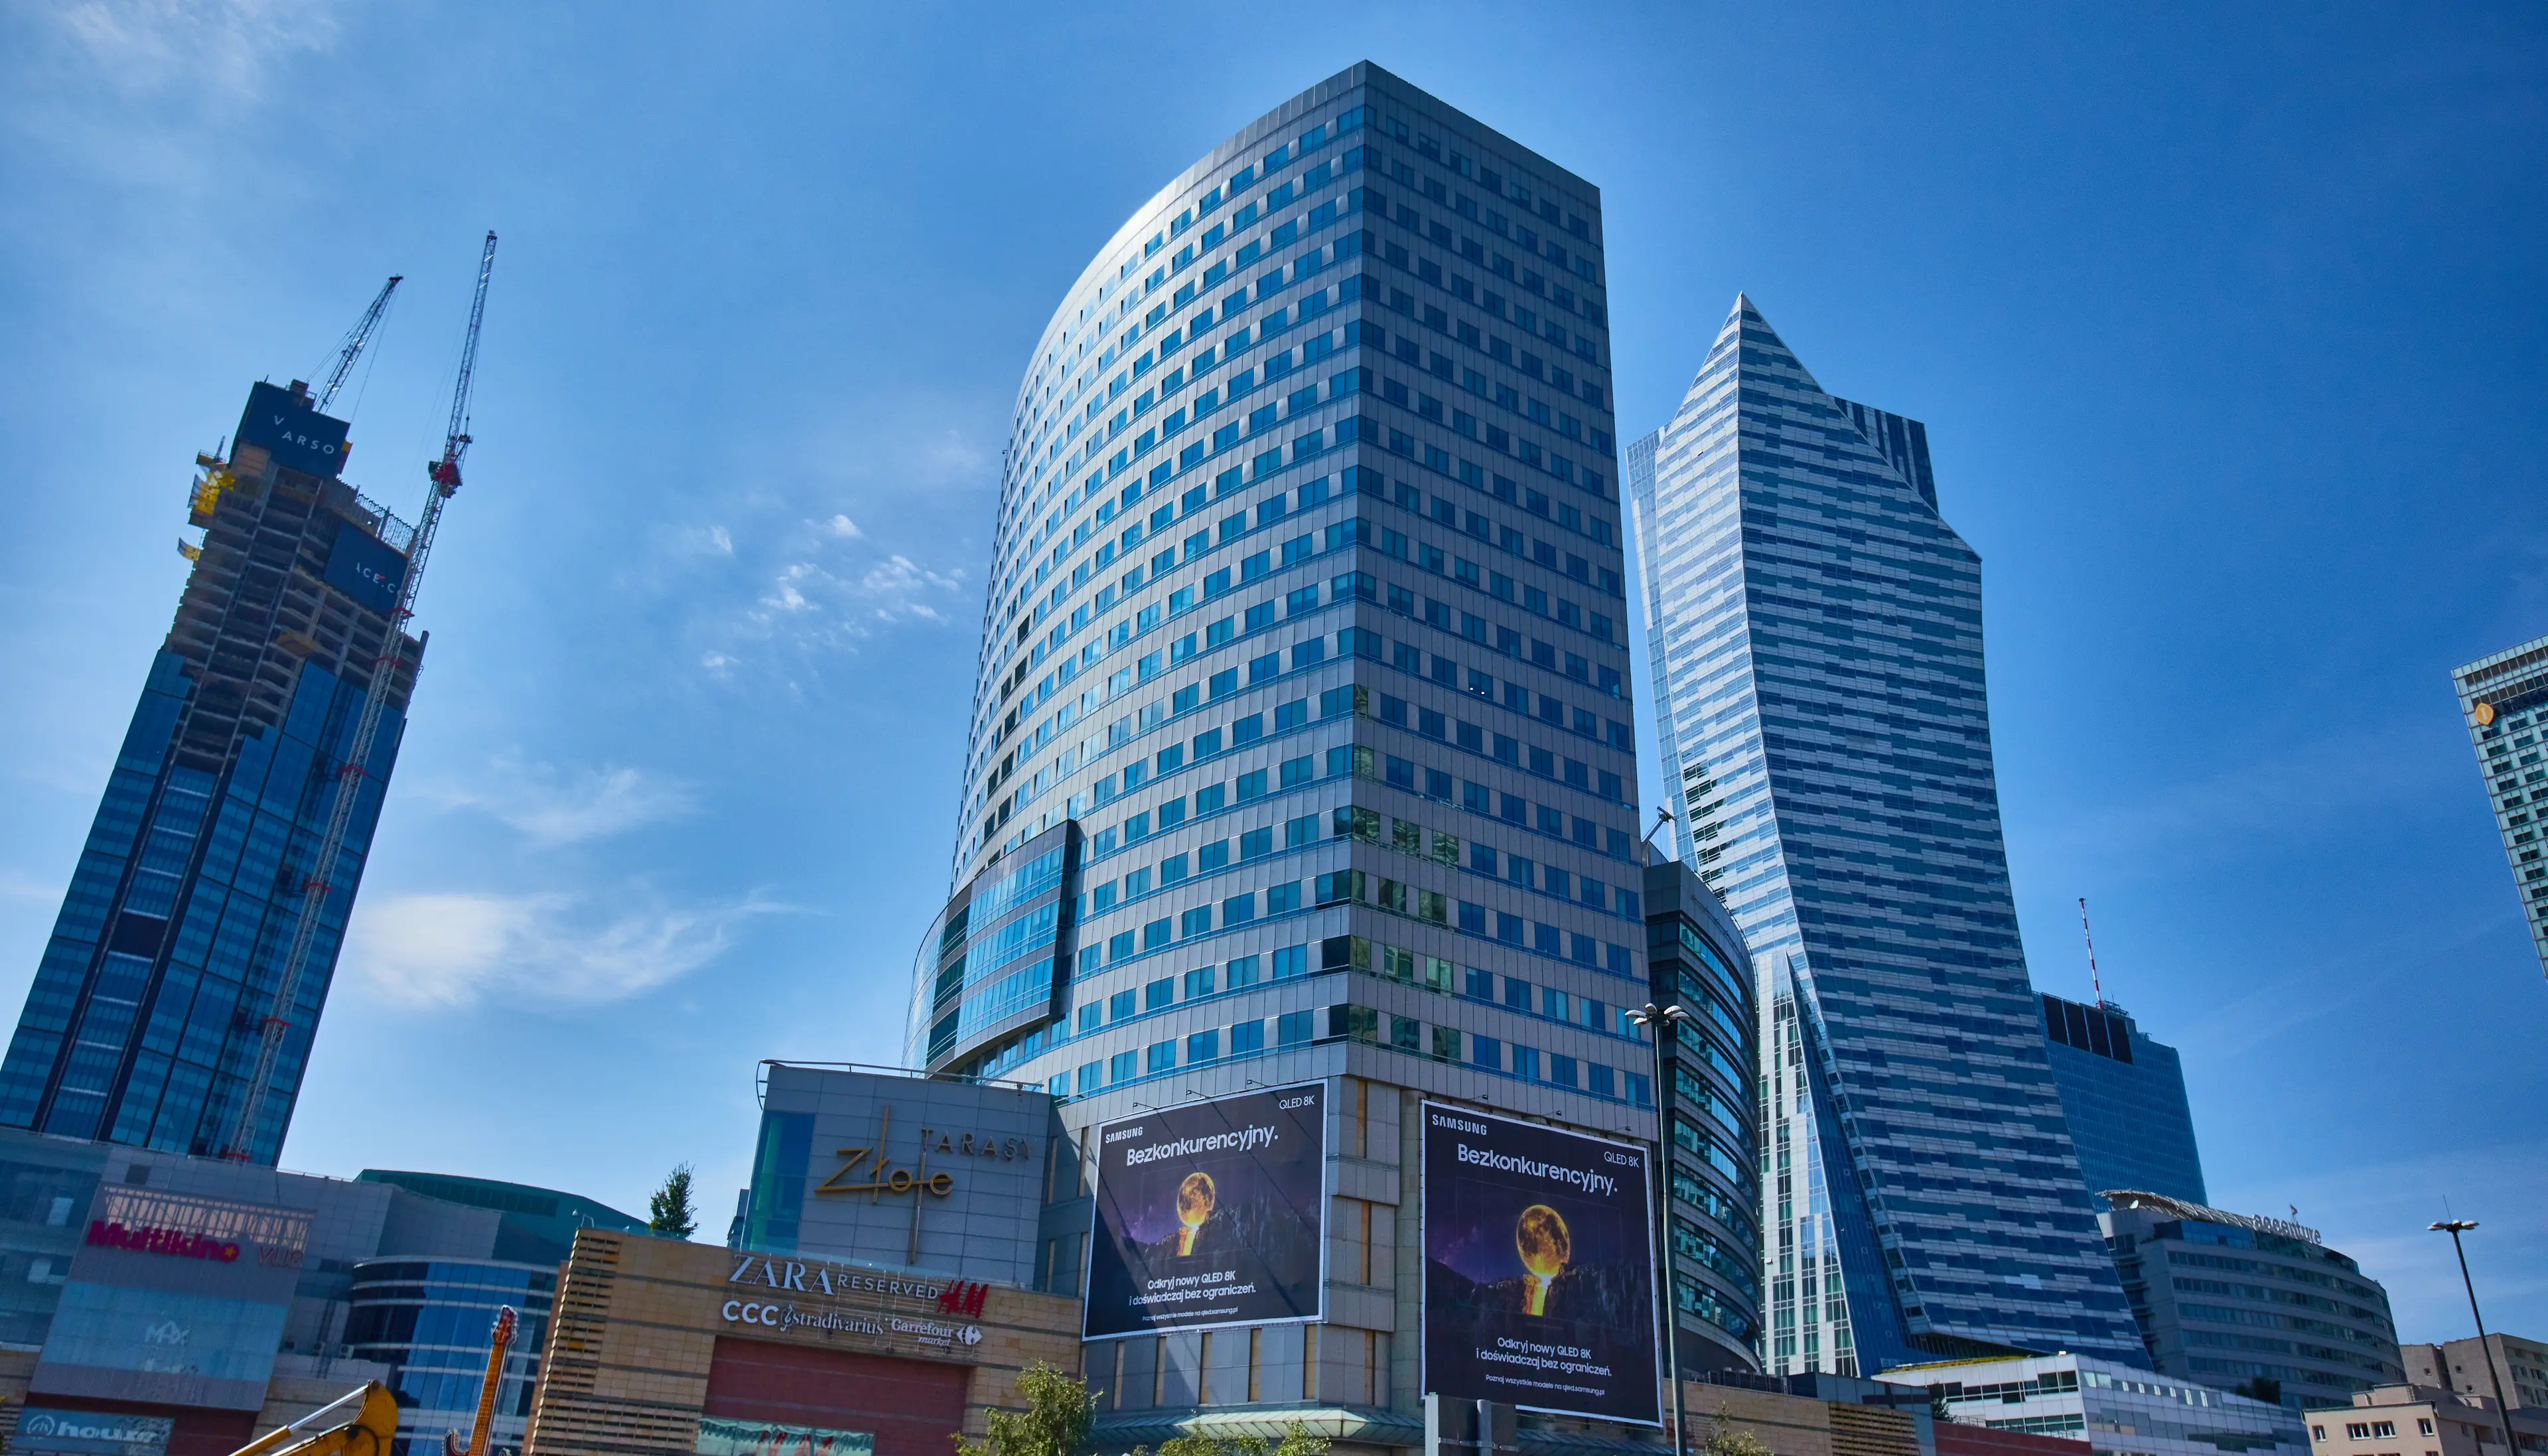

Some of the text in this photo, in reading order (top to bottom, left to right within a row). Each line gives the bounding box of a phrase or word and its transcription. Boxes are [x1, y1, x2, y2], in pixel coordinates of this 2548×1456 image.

[1279, 1094, 1315, 1110] QLED 8K
[1105, 1126, 1143, 1144] SAMSUNG
[1432, 1114, 1487, 1136] SAMSUNG
[921, 1129, 1034, 1161] TARASY
[1127, 1124, 1279, 1166] Bezkonkurencyjny.
[1458, 1144, 1618, 1196] Bezkonkurencyjny.
[1604, 1151, 1640, 1168] QLED 8K
[86, 1221, 240, 1263] Multikino
[729, 1254, 989, 1319] ZARA RESERVED H&M
[1148, 1270, 1236, 1290] Odkryj nowy QLED 8K
[1133, 1290, 1184, 1305] doświadczaj
[1184, 1290, 1201, 1299] bez
[1203, 1282, 1256, 1300] ograniczeń.
[722, 1300, 954, 1337] CCC stradivarius Carrefour
[1497, 1337, 1592, 1359] Odkryj nowy QLED 8K
[1476, 1347, 1612, 1376] i doświadczaj bez ograniczeń.
[1486, 1374, 1504, 1384] Poznaj
